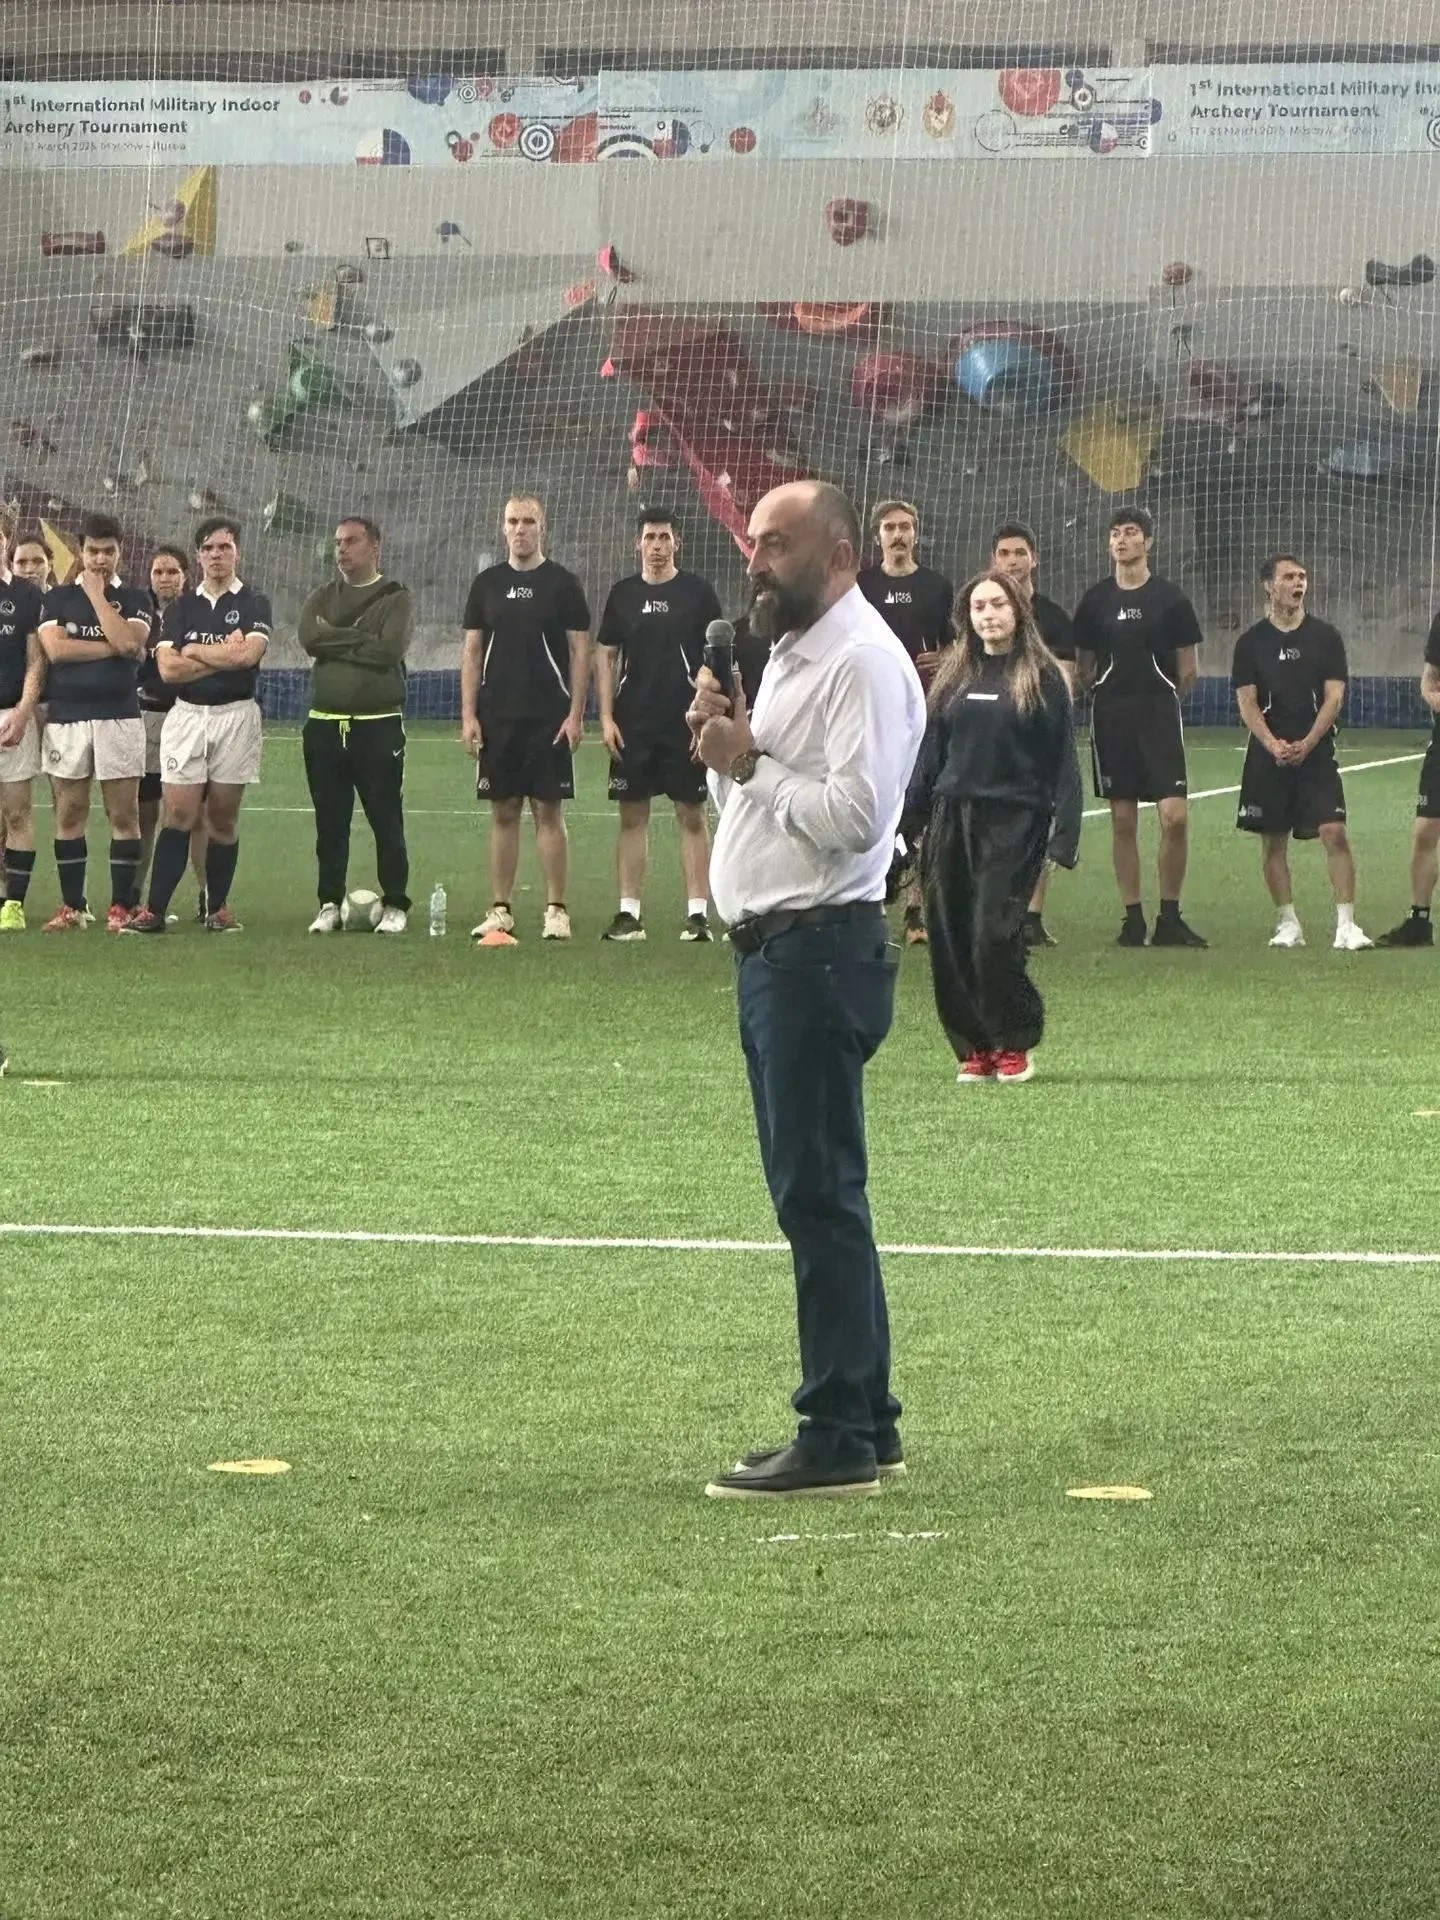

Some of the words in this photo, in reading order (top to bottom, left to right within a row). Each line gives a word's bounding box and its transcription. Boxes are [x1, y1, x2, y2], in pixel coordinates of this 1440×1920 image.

[1217, 82, 1335, 97] International
[1340, 81, 1409, 99] Military
[31, 97, 145, 112] International
[150, 97, 217, 114] Military
[222, 98, 281, 112] Indoor
[1191, 103, 1262, 121] Archery
[1267, 102, 1380, 118] Tournament
[4, 119, 75, 138] Archery
[79, 120, 188, 133] Tournament
